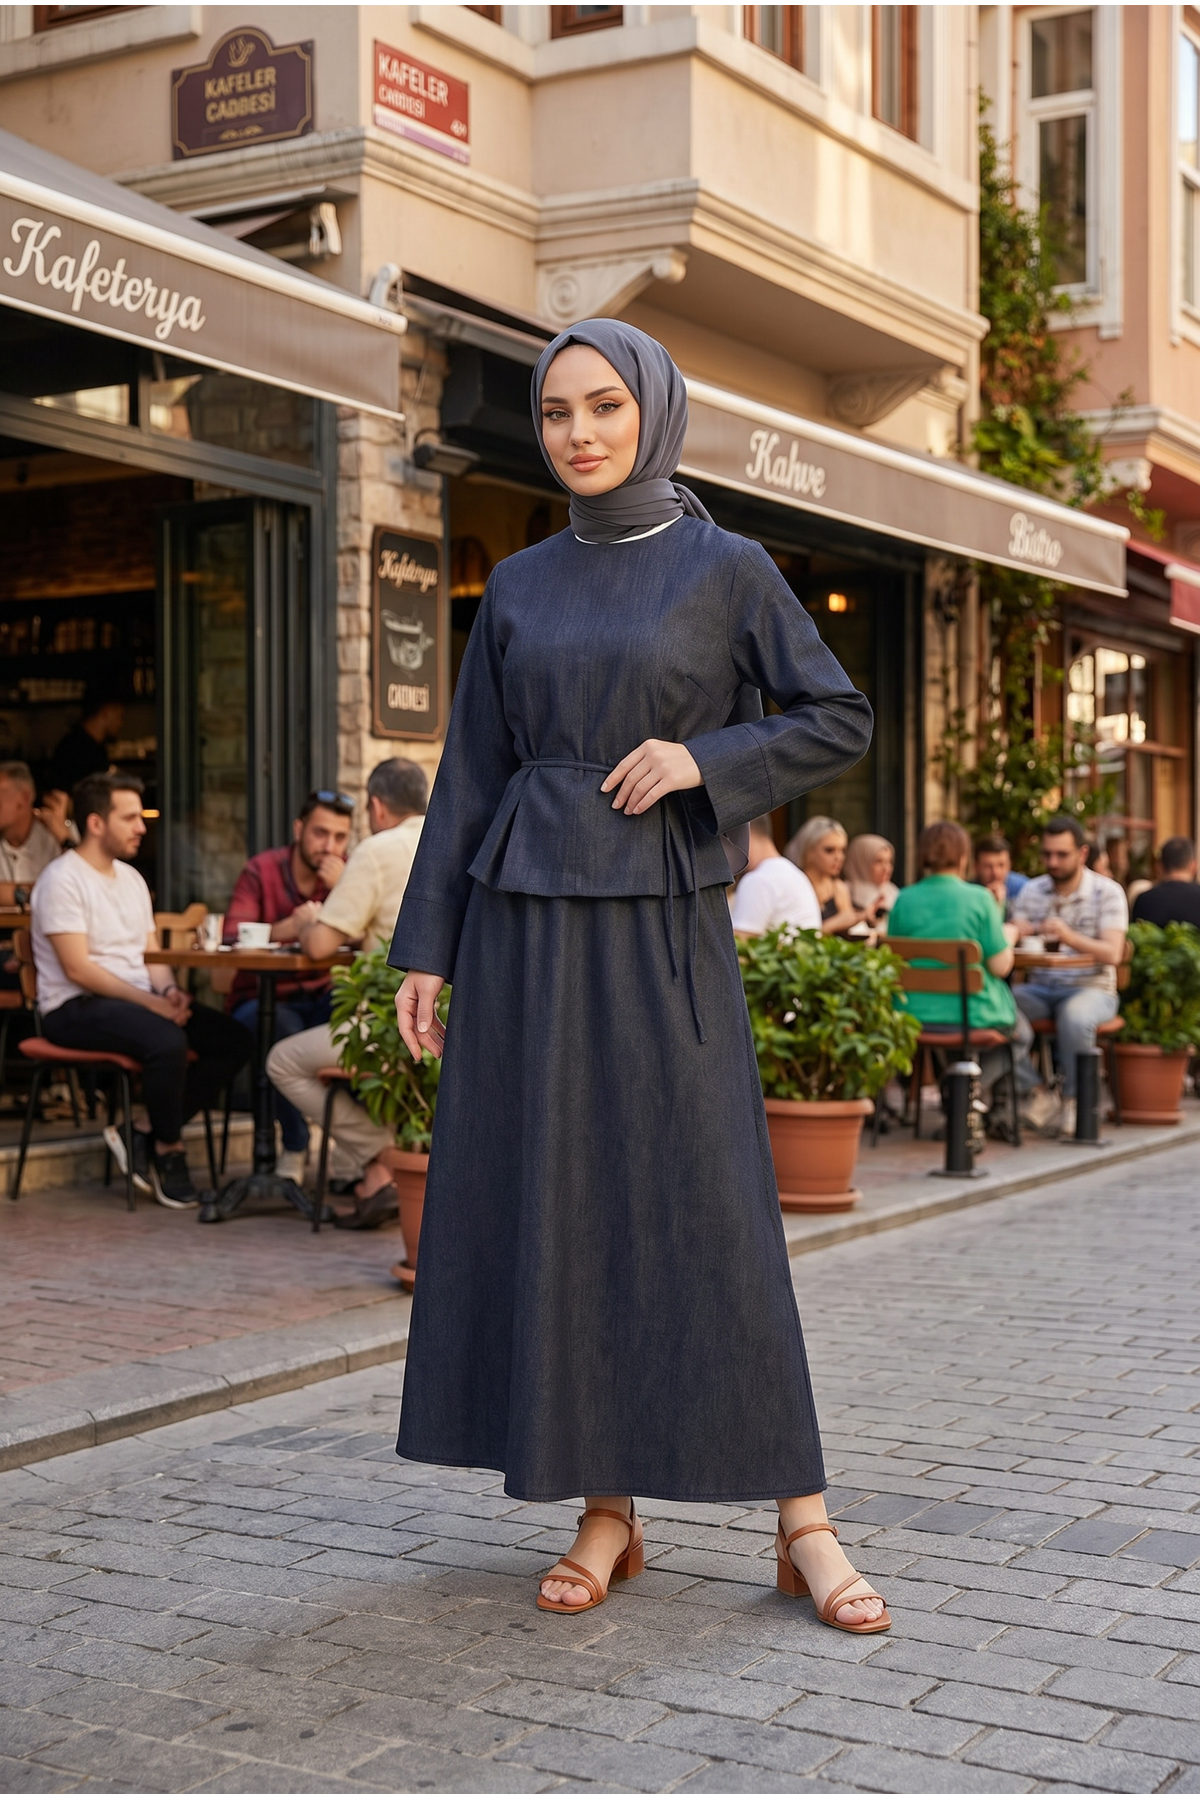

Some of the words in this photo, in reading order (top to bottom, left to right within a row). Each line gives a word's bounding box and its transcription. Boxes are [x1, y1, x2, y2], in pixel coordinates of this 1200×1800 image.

[205, 66, 276, 99] KAFELER
[379, 51, 449, 108] KAFELER
[3, 218, 206, 340] Kafeterya
[745, 429, 827, 498] Kahve
